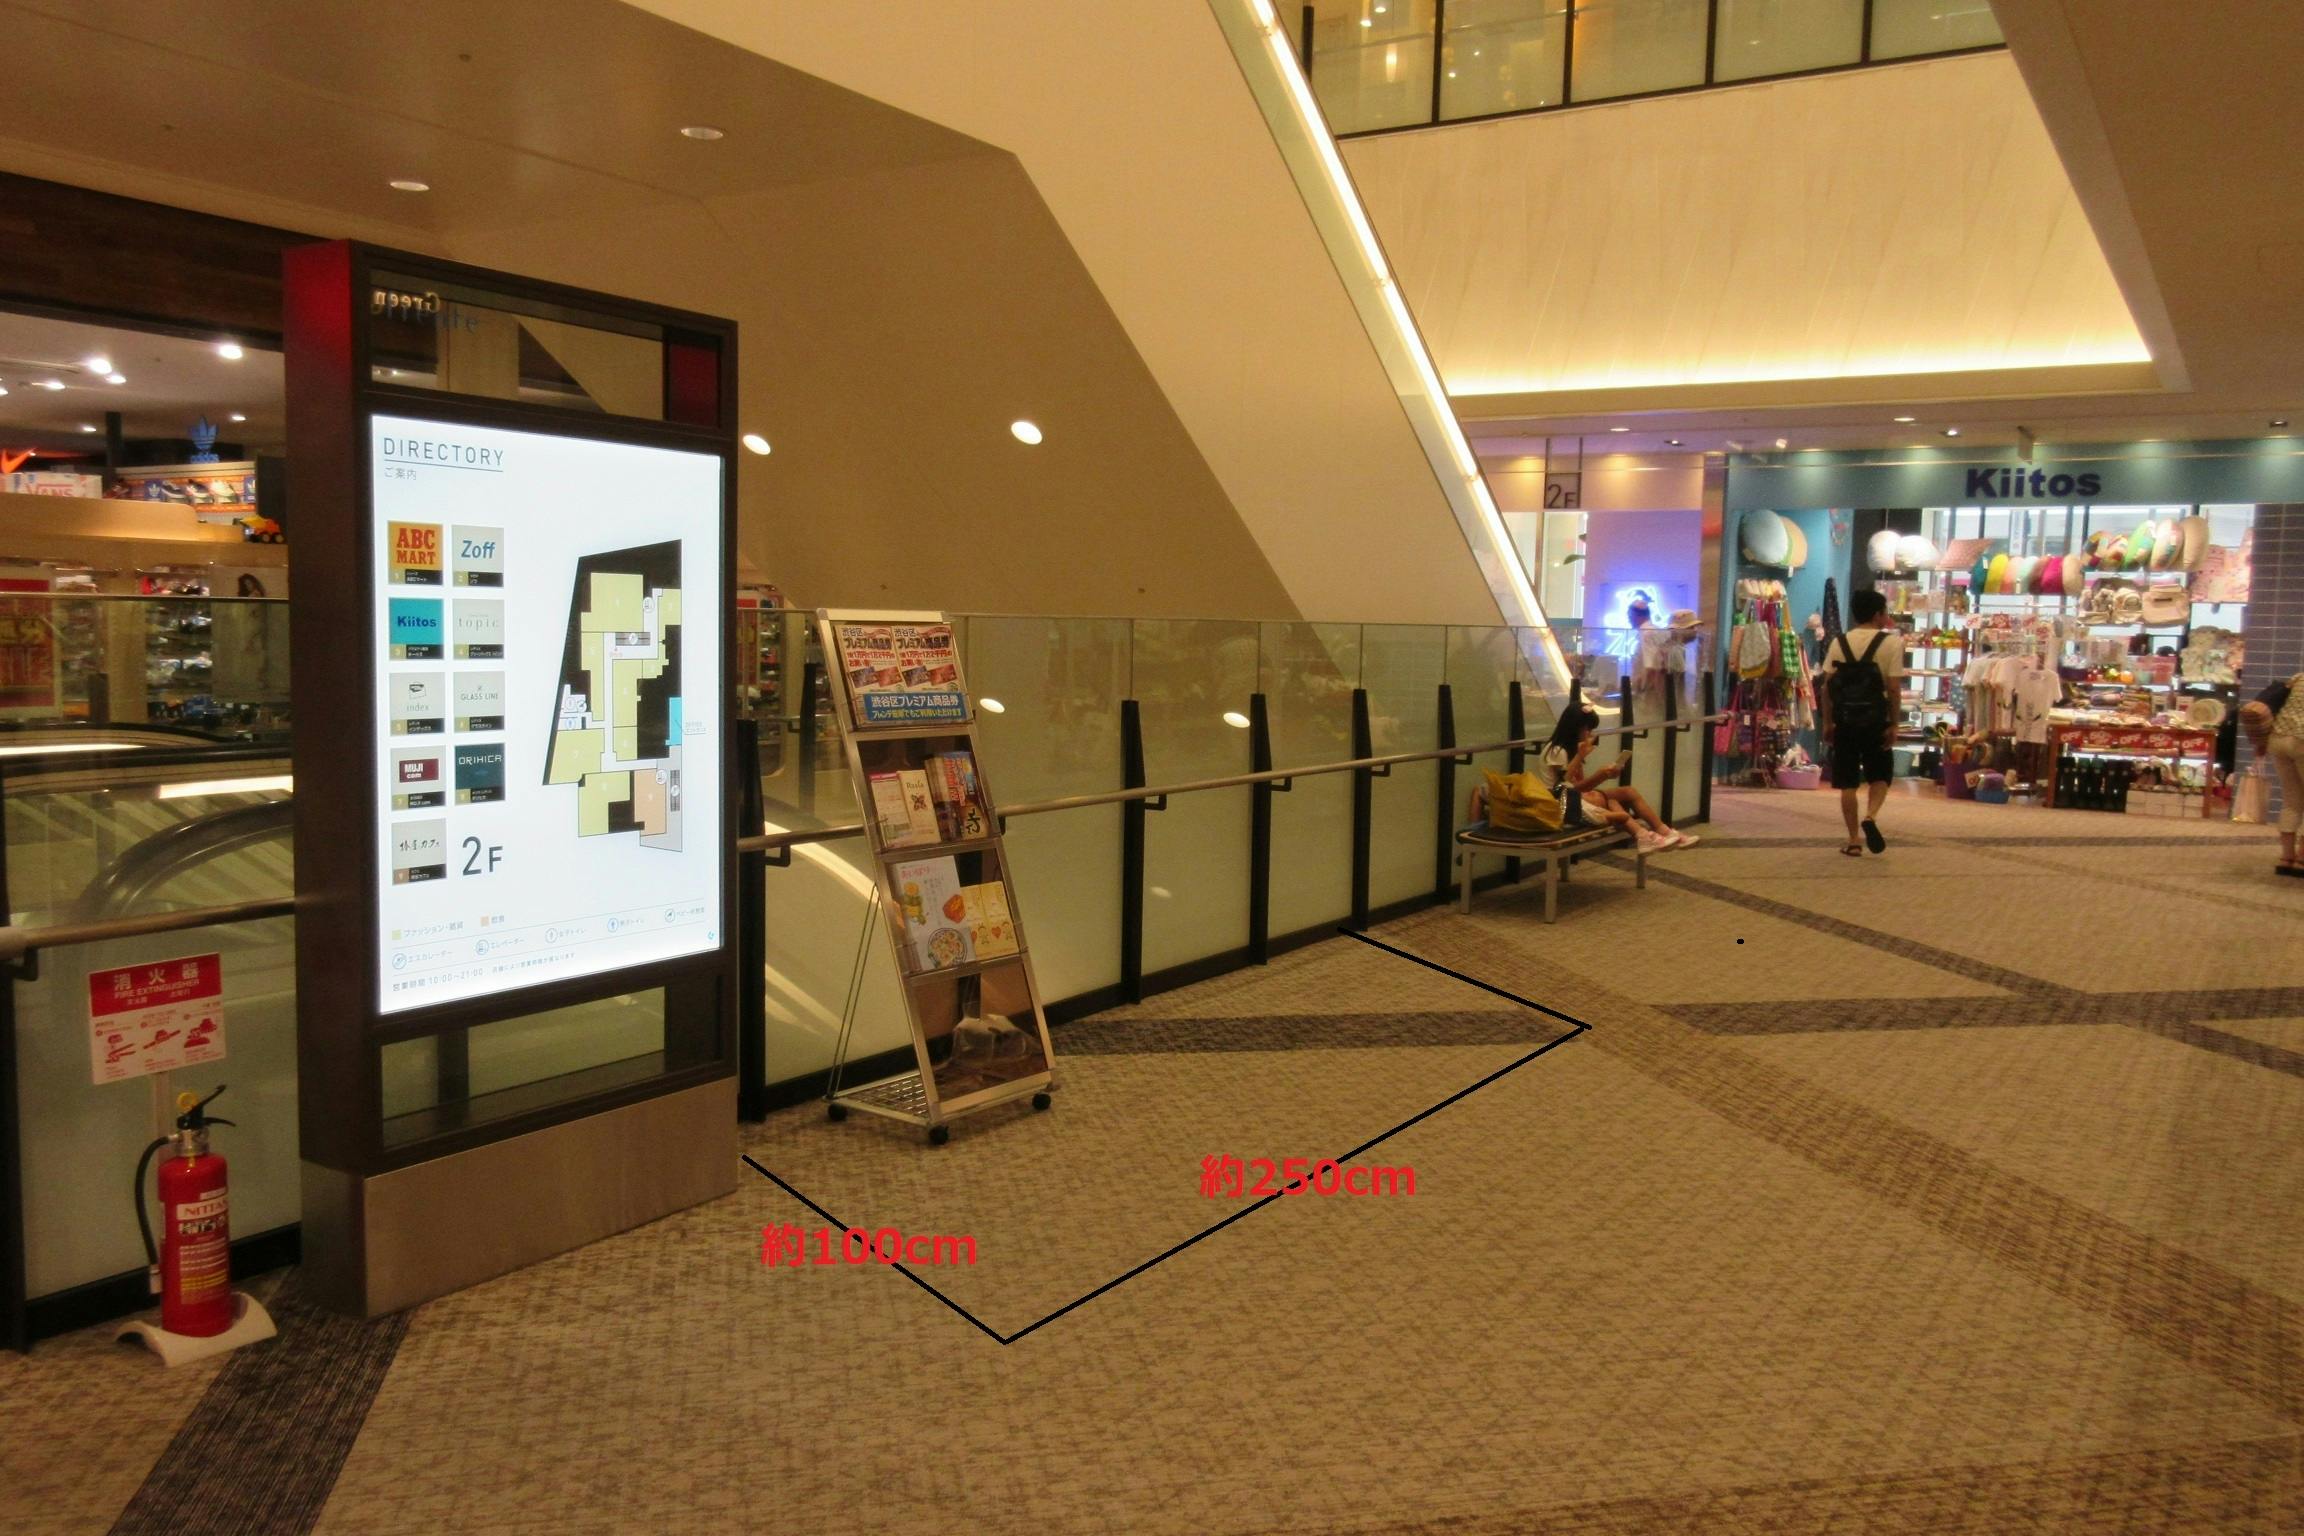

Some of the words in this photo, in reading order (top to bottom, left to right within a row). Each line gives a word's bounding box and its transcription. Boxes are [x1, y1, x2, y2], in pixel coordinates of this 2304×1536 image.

[383, 437, 504, 466] DIRECTORY
[384, 467, 417, 480] ご案内
[1966, 467, 2101, 498] Kiitos
[1548, 483, 1577, 509] 2F
[396, 527, 436, 550] ABC
[461, 540, 495, 559] Zoff
[396, 550, 436, 565] MART
[397, 616, 437, 628] Kiitos
[458, 618, 500, 631] topic
[460, 693, 483, 701] GLASS
[871, 695, 959, 708] 渋谷区プレミアム商品券
[407, 702, 429, 712] index
[2060, 730, 2082, 742] OFF
[2119, 733, 2142, 745] OFF
[2181, 737, 2205, 749] OFF
[458, 754, 502, 765] ORIHICA
[404, 763, 424, 773] MUJI
[462, 836, 504, 876] 2F
[114, 962, 199, 991] 消火器
[114, 988, 137, 999] FIRE
